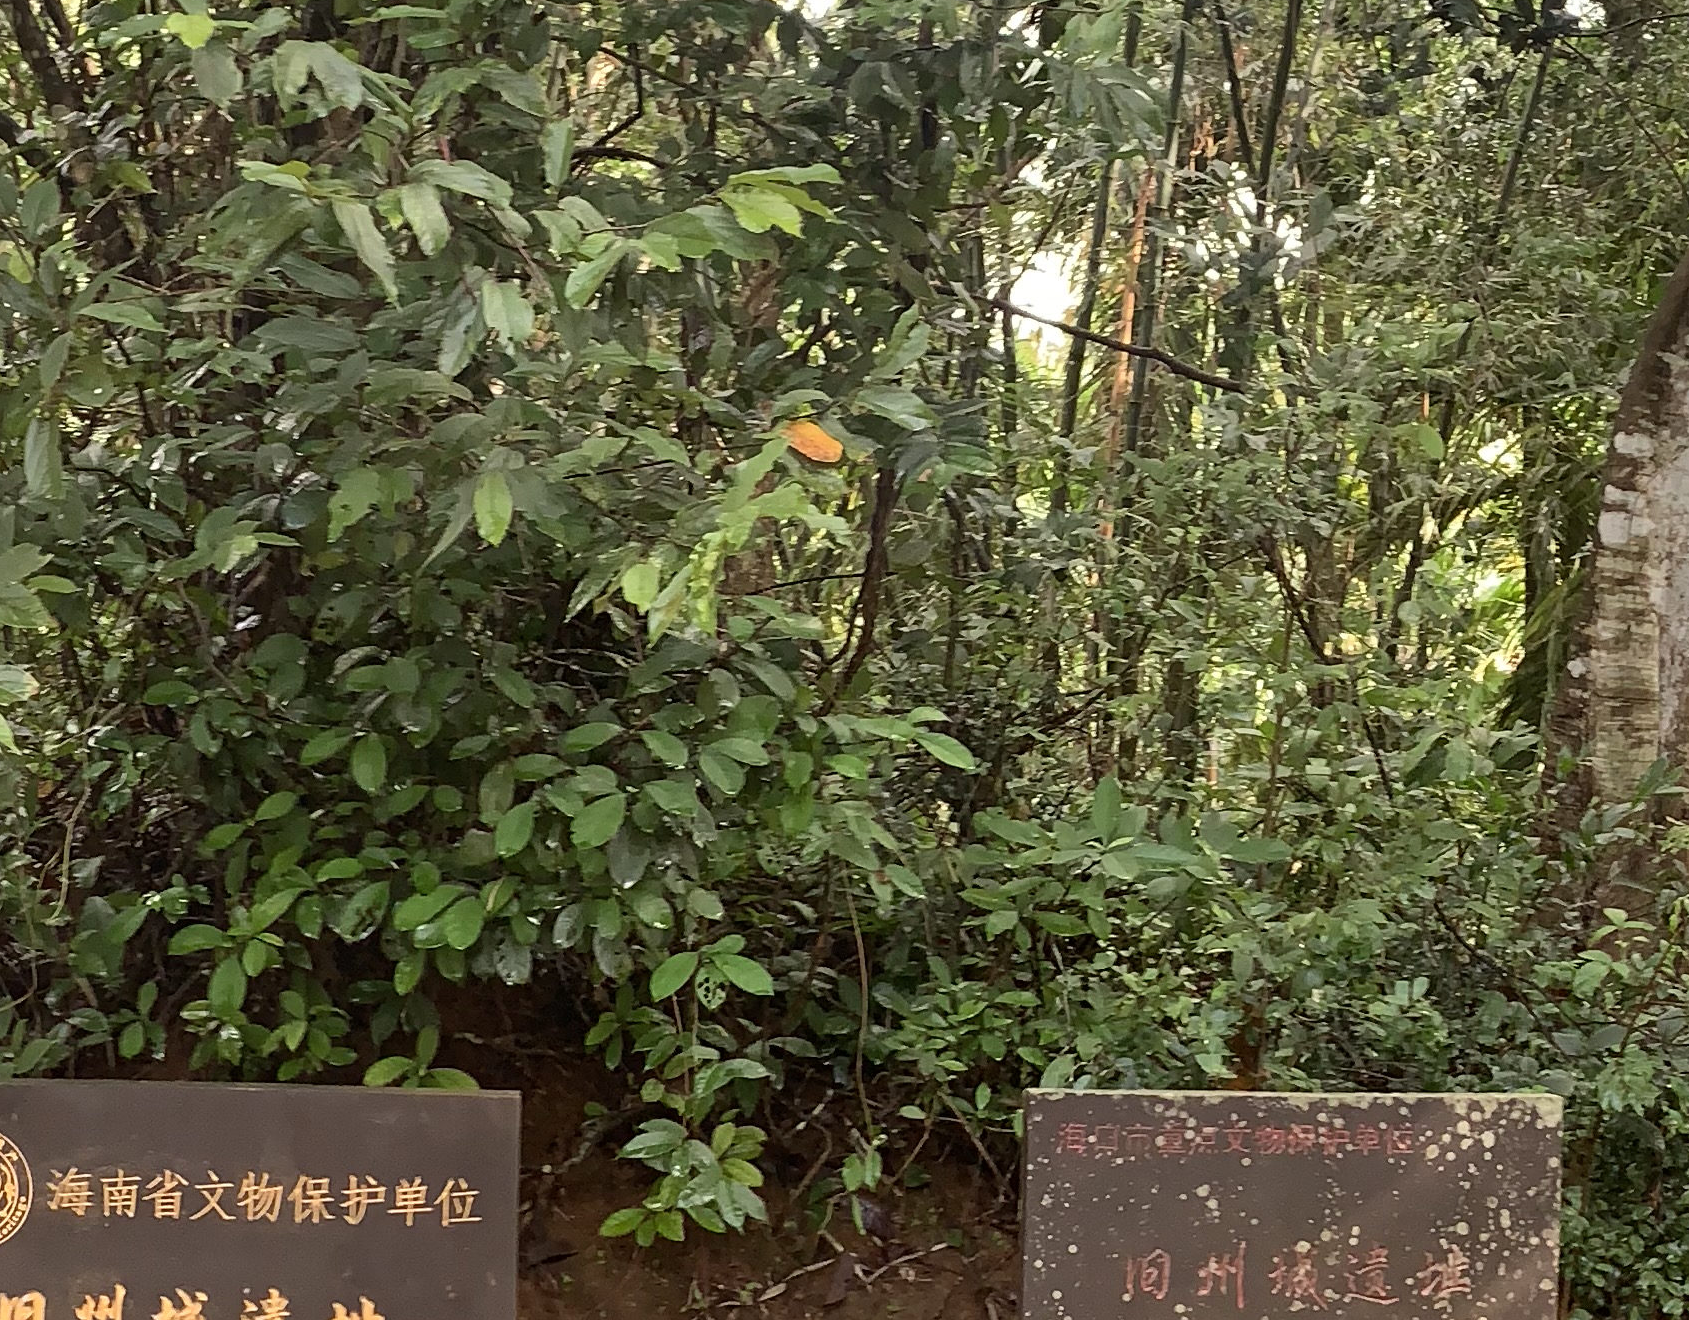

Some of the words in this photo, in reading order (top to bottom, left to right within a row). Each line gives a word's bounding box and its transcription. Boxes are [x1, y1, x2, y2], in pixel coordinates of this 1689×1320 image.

[1058, 1122, 1415, 1155] 海口市重点文物保护单位
[45, 1166, 484, 1227] 海南省文物保护单位
